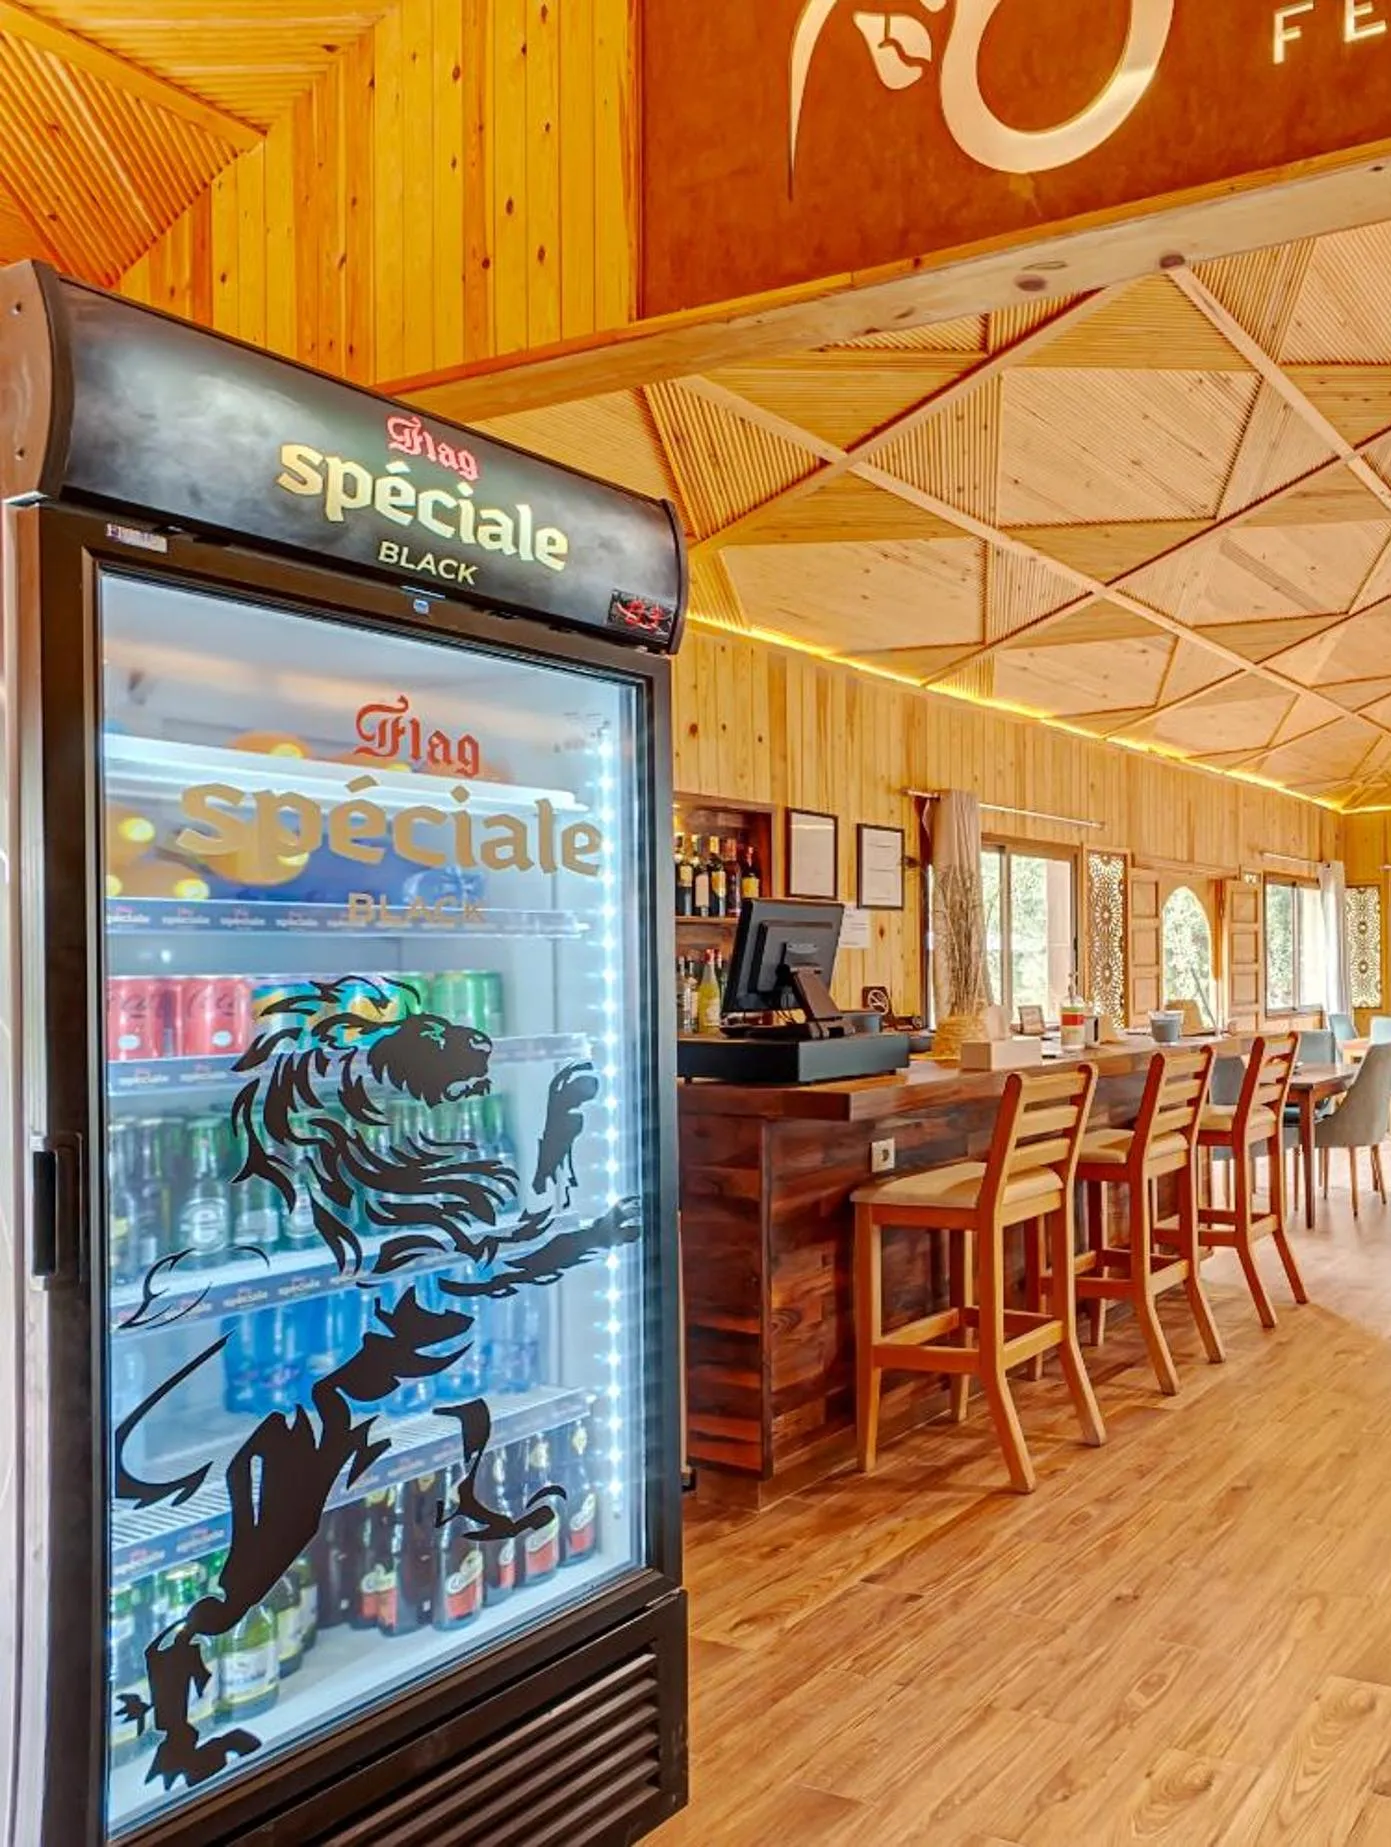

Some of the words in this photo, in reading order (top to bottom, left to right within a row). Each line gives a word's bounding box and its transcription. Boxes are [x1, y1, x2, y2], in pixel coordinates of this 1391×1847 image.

[386, 415, 480, 481] Flag
[276, 443, 570, 572] spéciale
[377, 540, 479, 585] BLACK
[353, 695, 480, 779] Flag
[175, 774, 601, 877] spéciale
[347, 892, 486, 925] BLACK
